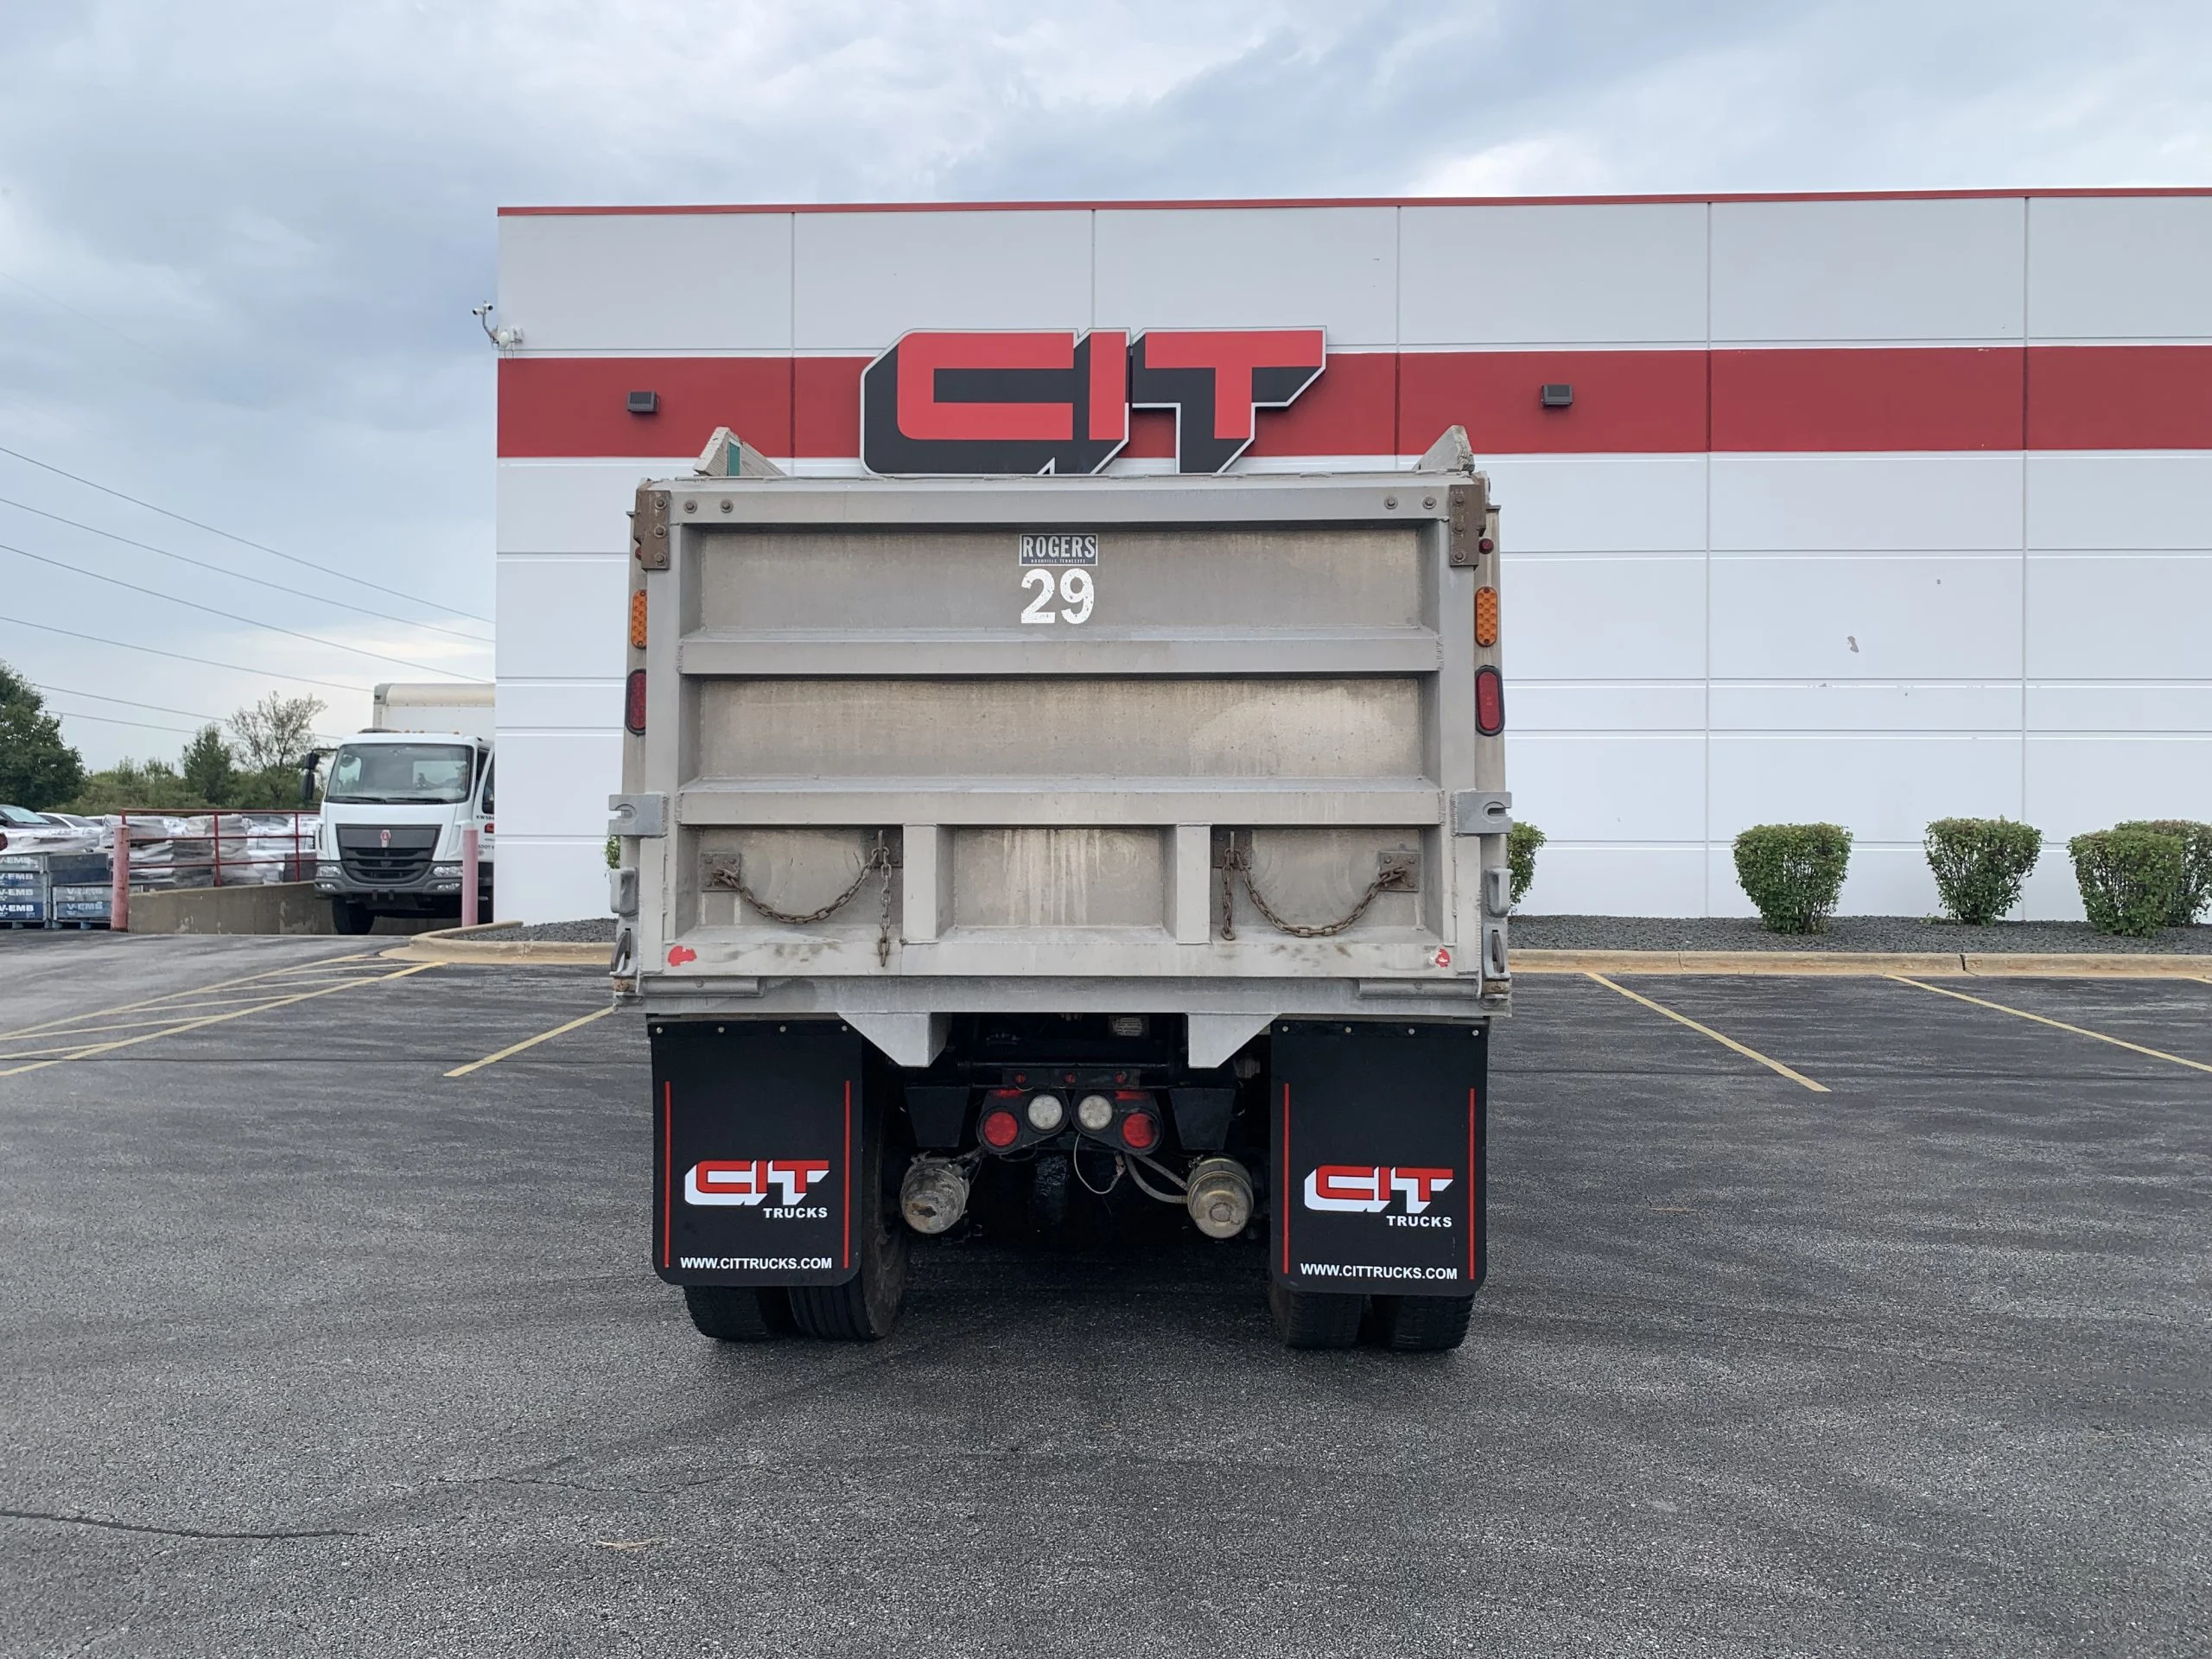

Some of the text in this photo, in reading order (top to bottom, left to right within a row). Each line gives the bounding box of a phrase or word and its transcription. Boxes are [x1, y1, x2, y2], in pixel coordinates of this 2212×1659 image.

[861, 327, 1326, 475] CIT
[1022, 536, 1096, 558] ROGERS
[1020, 568, 1095, 625] 29
[683, 1160, 830, 1206] CIT
[1304, 1165, 1454, 1215] CIT
[763, 1207, 829, 1219] TRUCKS
[1386, 1215, 1452, 1228] TRUCKS
[680, 1256, 833, 1270] WWW.CITTRUCKS.COM
[1300, 1262, 1458, 1281] WWW.CITTRUCKS.COM
